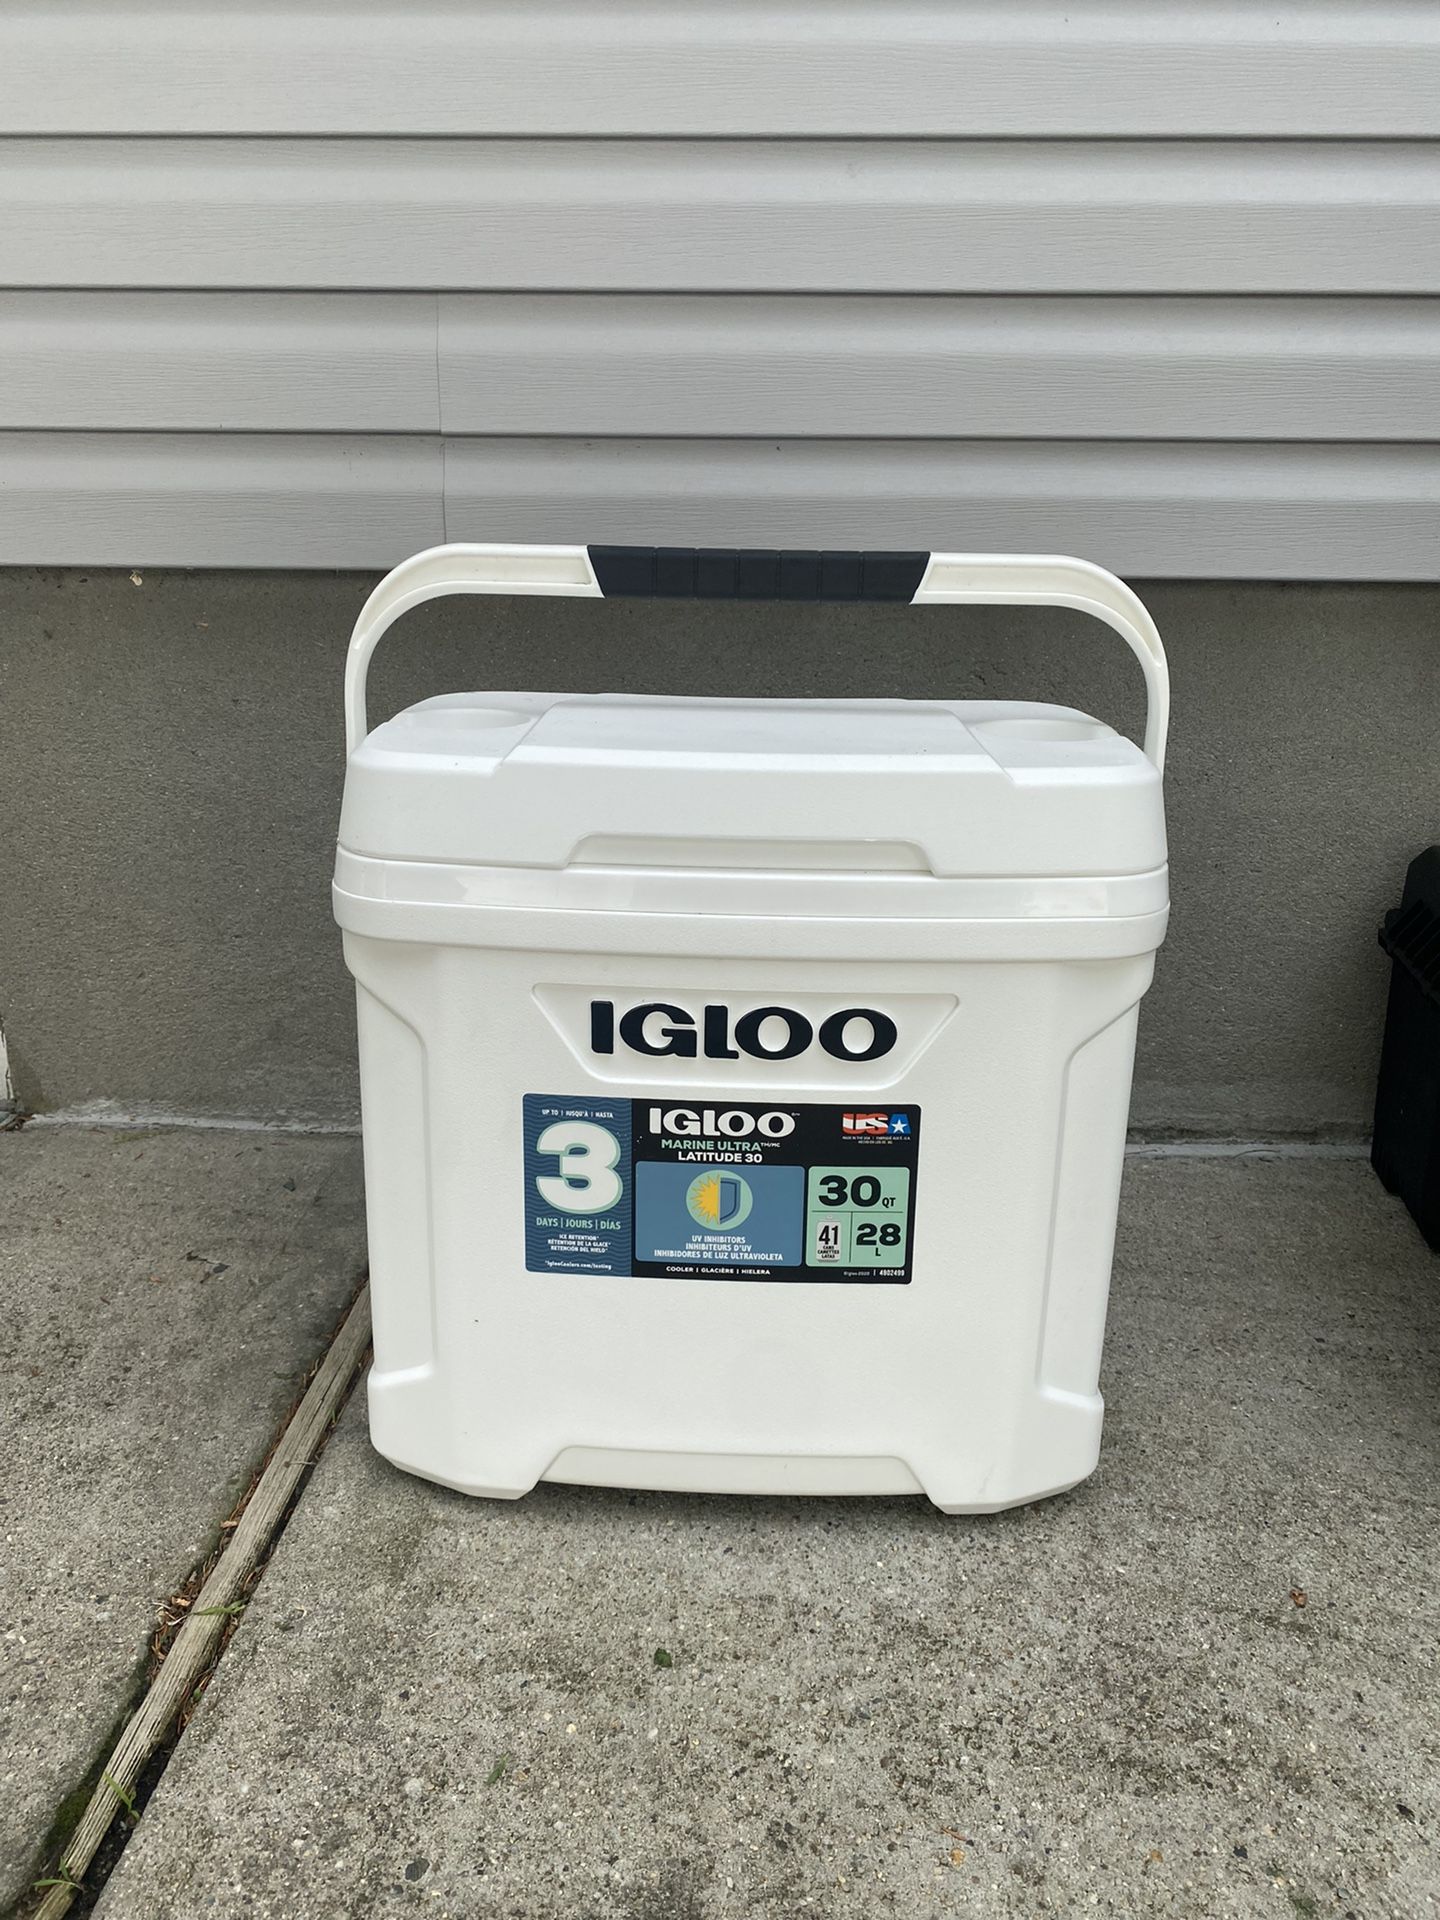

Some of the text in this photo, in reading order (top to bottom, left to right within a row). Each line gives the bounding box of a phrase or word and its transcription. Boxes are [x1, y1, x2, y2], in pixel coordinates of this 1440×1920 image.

[590, 1000, 898, 1062] IGLOO
[649, 1107, 796, 1138] IGLOO
[842, 1113, 912, 1135] USA
[661, 1139, 714, 1150] MARINE
[717, 1141, 762, 1152] ULTRA
[678, 1151, 763, 1164] LATITUDE 30
[536, 1120, 623, 1214] 3
[818, 1175, 896, 1208] 30 QT
[536, 1217, 559, 1227] DAYS
[565, 1219, 593, 1229] JOURS
[600, 1219, 621, 1230] DÍAS
[704, 1235, 746, 1244] INHIBITORS
[819, 1225, 839, 1245] 41
[856, 1223, 901, 1246] 28
[686, 1242, 752, 1252] INHIBITEURS D'UV
[875, 1247, 881, 1257] L
[654, 1249, 784, 1261] INHIBIDORES DE LUZ ULTRAVIOLETA
[666, 1265, 694, 1273] COOLER
[701, 1267, 734, 1275] GLACIÈRE
